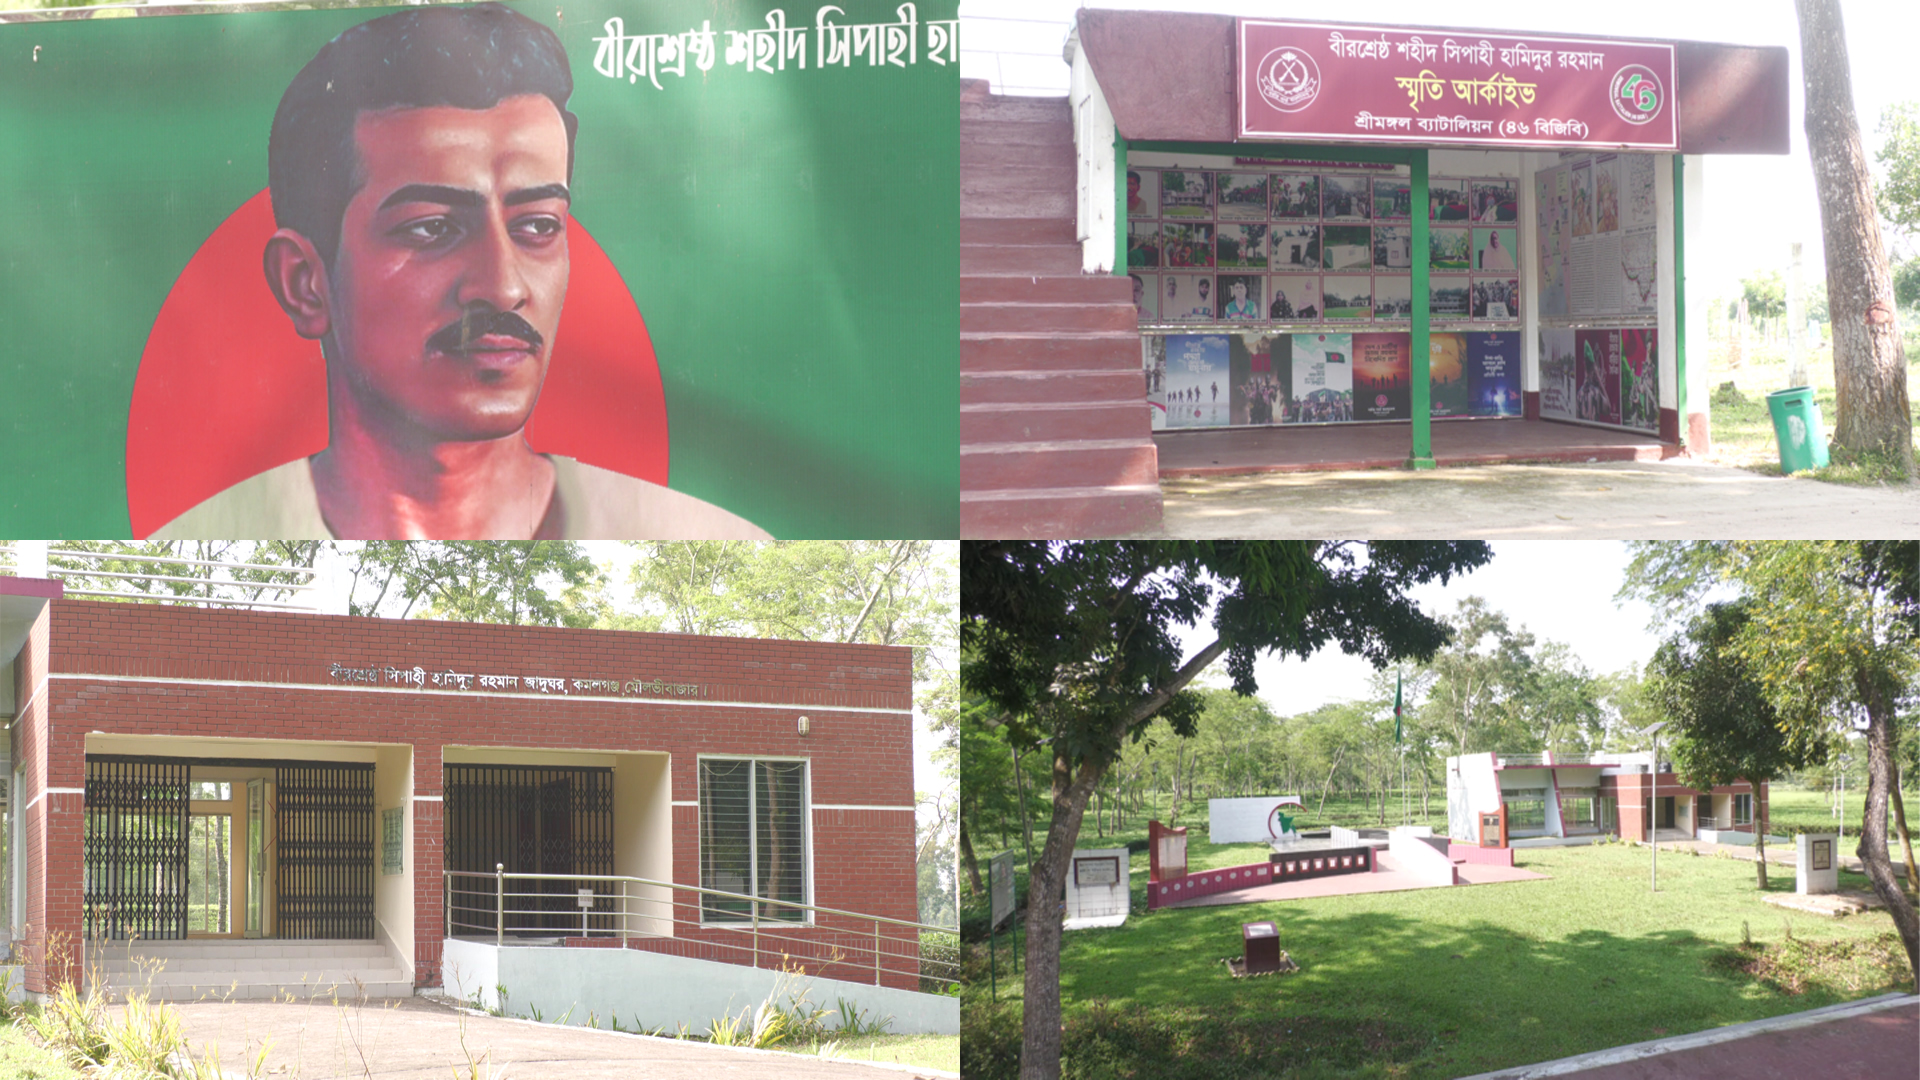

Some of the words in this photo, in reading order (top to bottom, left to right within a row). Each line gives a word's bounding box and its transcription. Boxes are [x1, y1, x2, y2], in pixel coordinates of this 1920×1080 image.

[592, 17, 717, 91] বীরশ্রেষ্ঠ
[724, 9, 808, 74] শহীদ
[816, 2, 919, 69] সিপাহী
[926, 4, 960, 67] হা
[1328, 31, 1391, 60] বীরশ্রেষ্ঠ
[1395, 36, 1438, 64] শহীদ
[1442, 38, 1495, 67] সিপাহী
[1499, 42, 1553, 73] হামিদুর
[1557, 51, 1605, 71] রহমান
[1394, 69, 1446, 113] স্মৃতি
[1451, 72, 1537, 109] আর্কাইভ
[1354, 110, 1412, 132] শ্রীমঙ্গল
[1416, 114, 1494, 134] ব্যাটালিয়ন
[1498, 119, 1530, 138] (৪৬
[1533, 118, 1589, 139] বিজিবি)
[384, 666, 426, 686] সিপাহী
[479, 675, 519, 690] রহমান
[523, 675, 568, 696] জাদুঘর,
